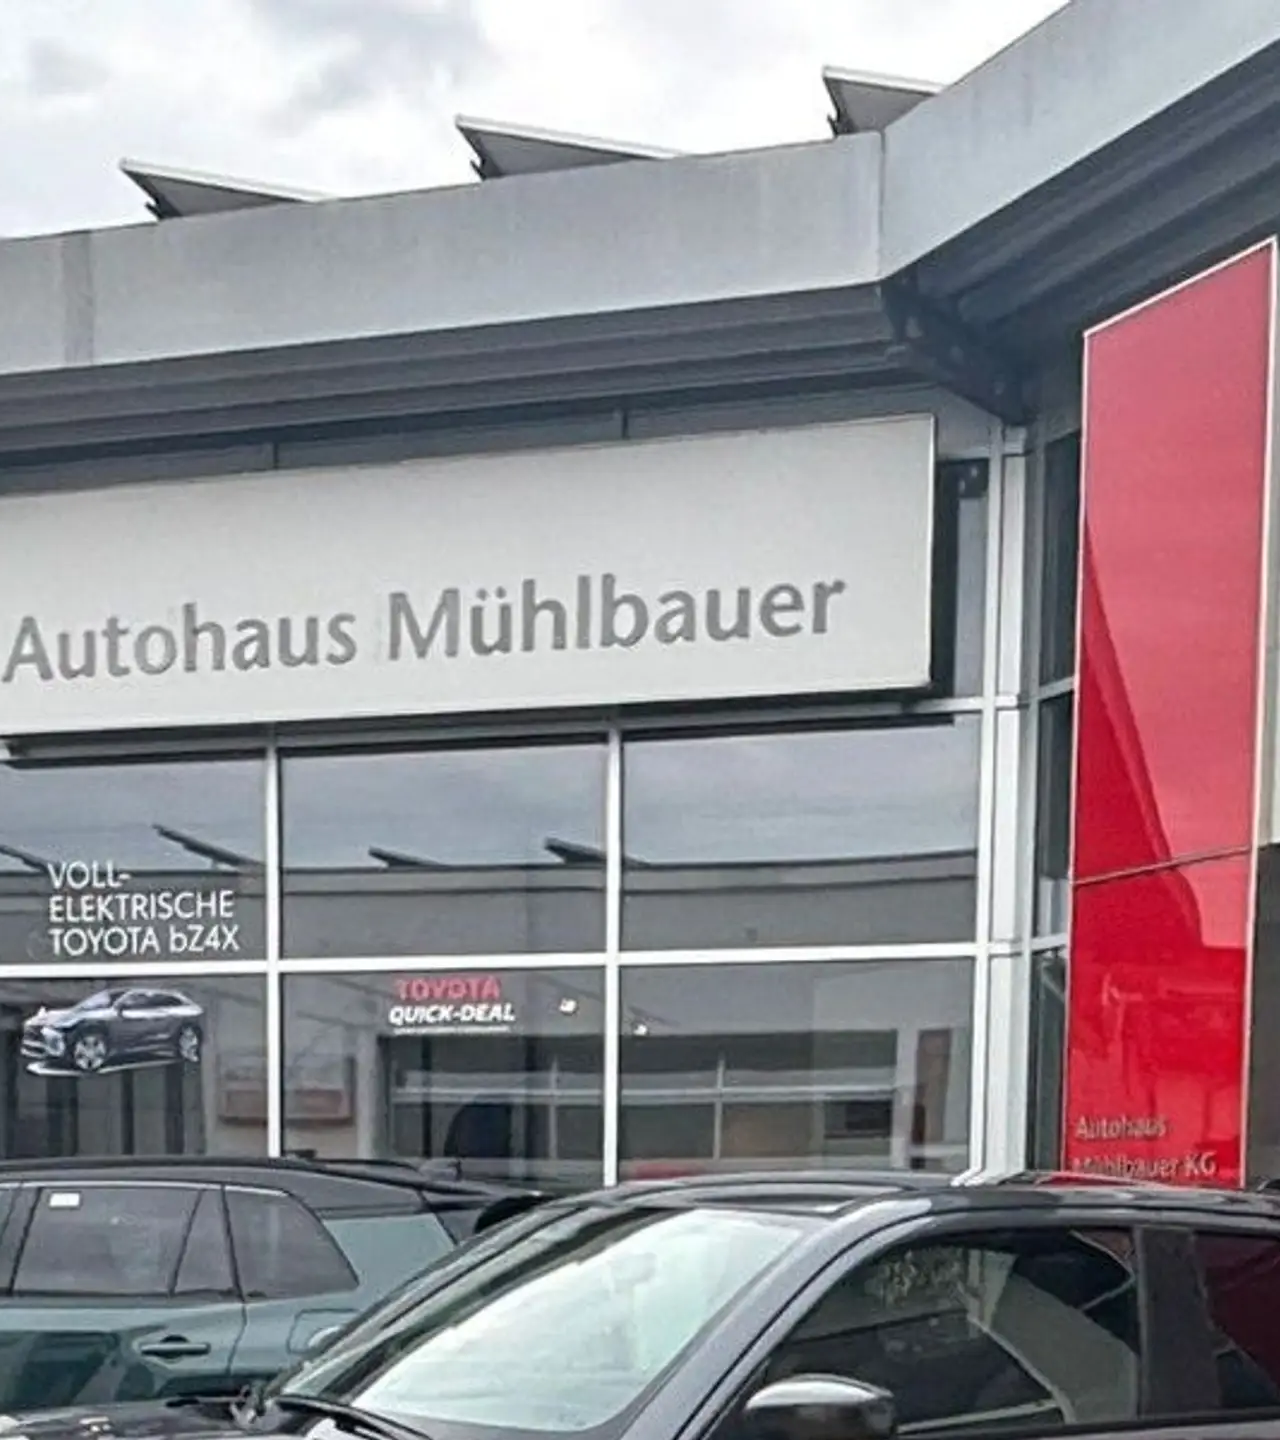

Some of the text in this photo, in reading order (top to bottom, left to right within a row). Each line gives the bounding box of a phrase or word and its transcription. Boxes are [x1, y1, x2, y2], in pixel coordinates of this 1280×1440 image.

[1, 573, 846, 683] Autohaus Mühlbauer
[47, 860, 131, 889] VOLL-
[49, 890, 235, 923] ELEKTRISCHE
[48, 924, 240, 956] TOYOTA bZ4X
[395, 976, 502, 1001] TOYOTA
[388, 1002, 516, 1026] QUICK-DEAL
[1075, 1115, 1167, 1139] Autohaus
[1184, 1151, 1217, 1176] KG
